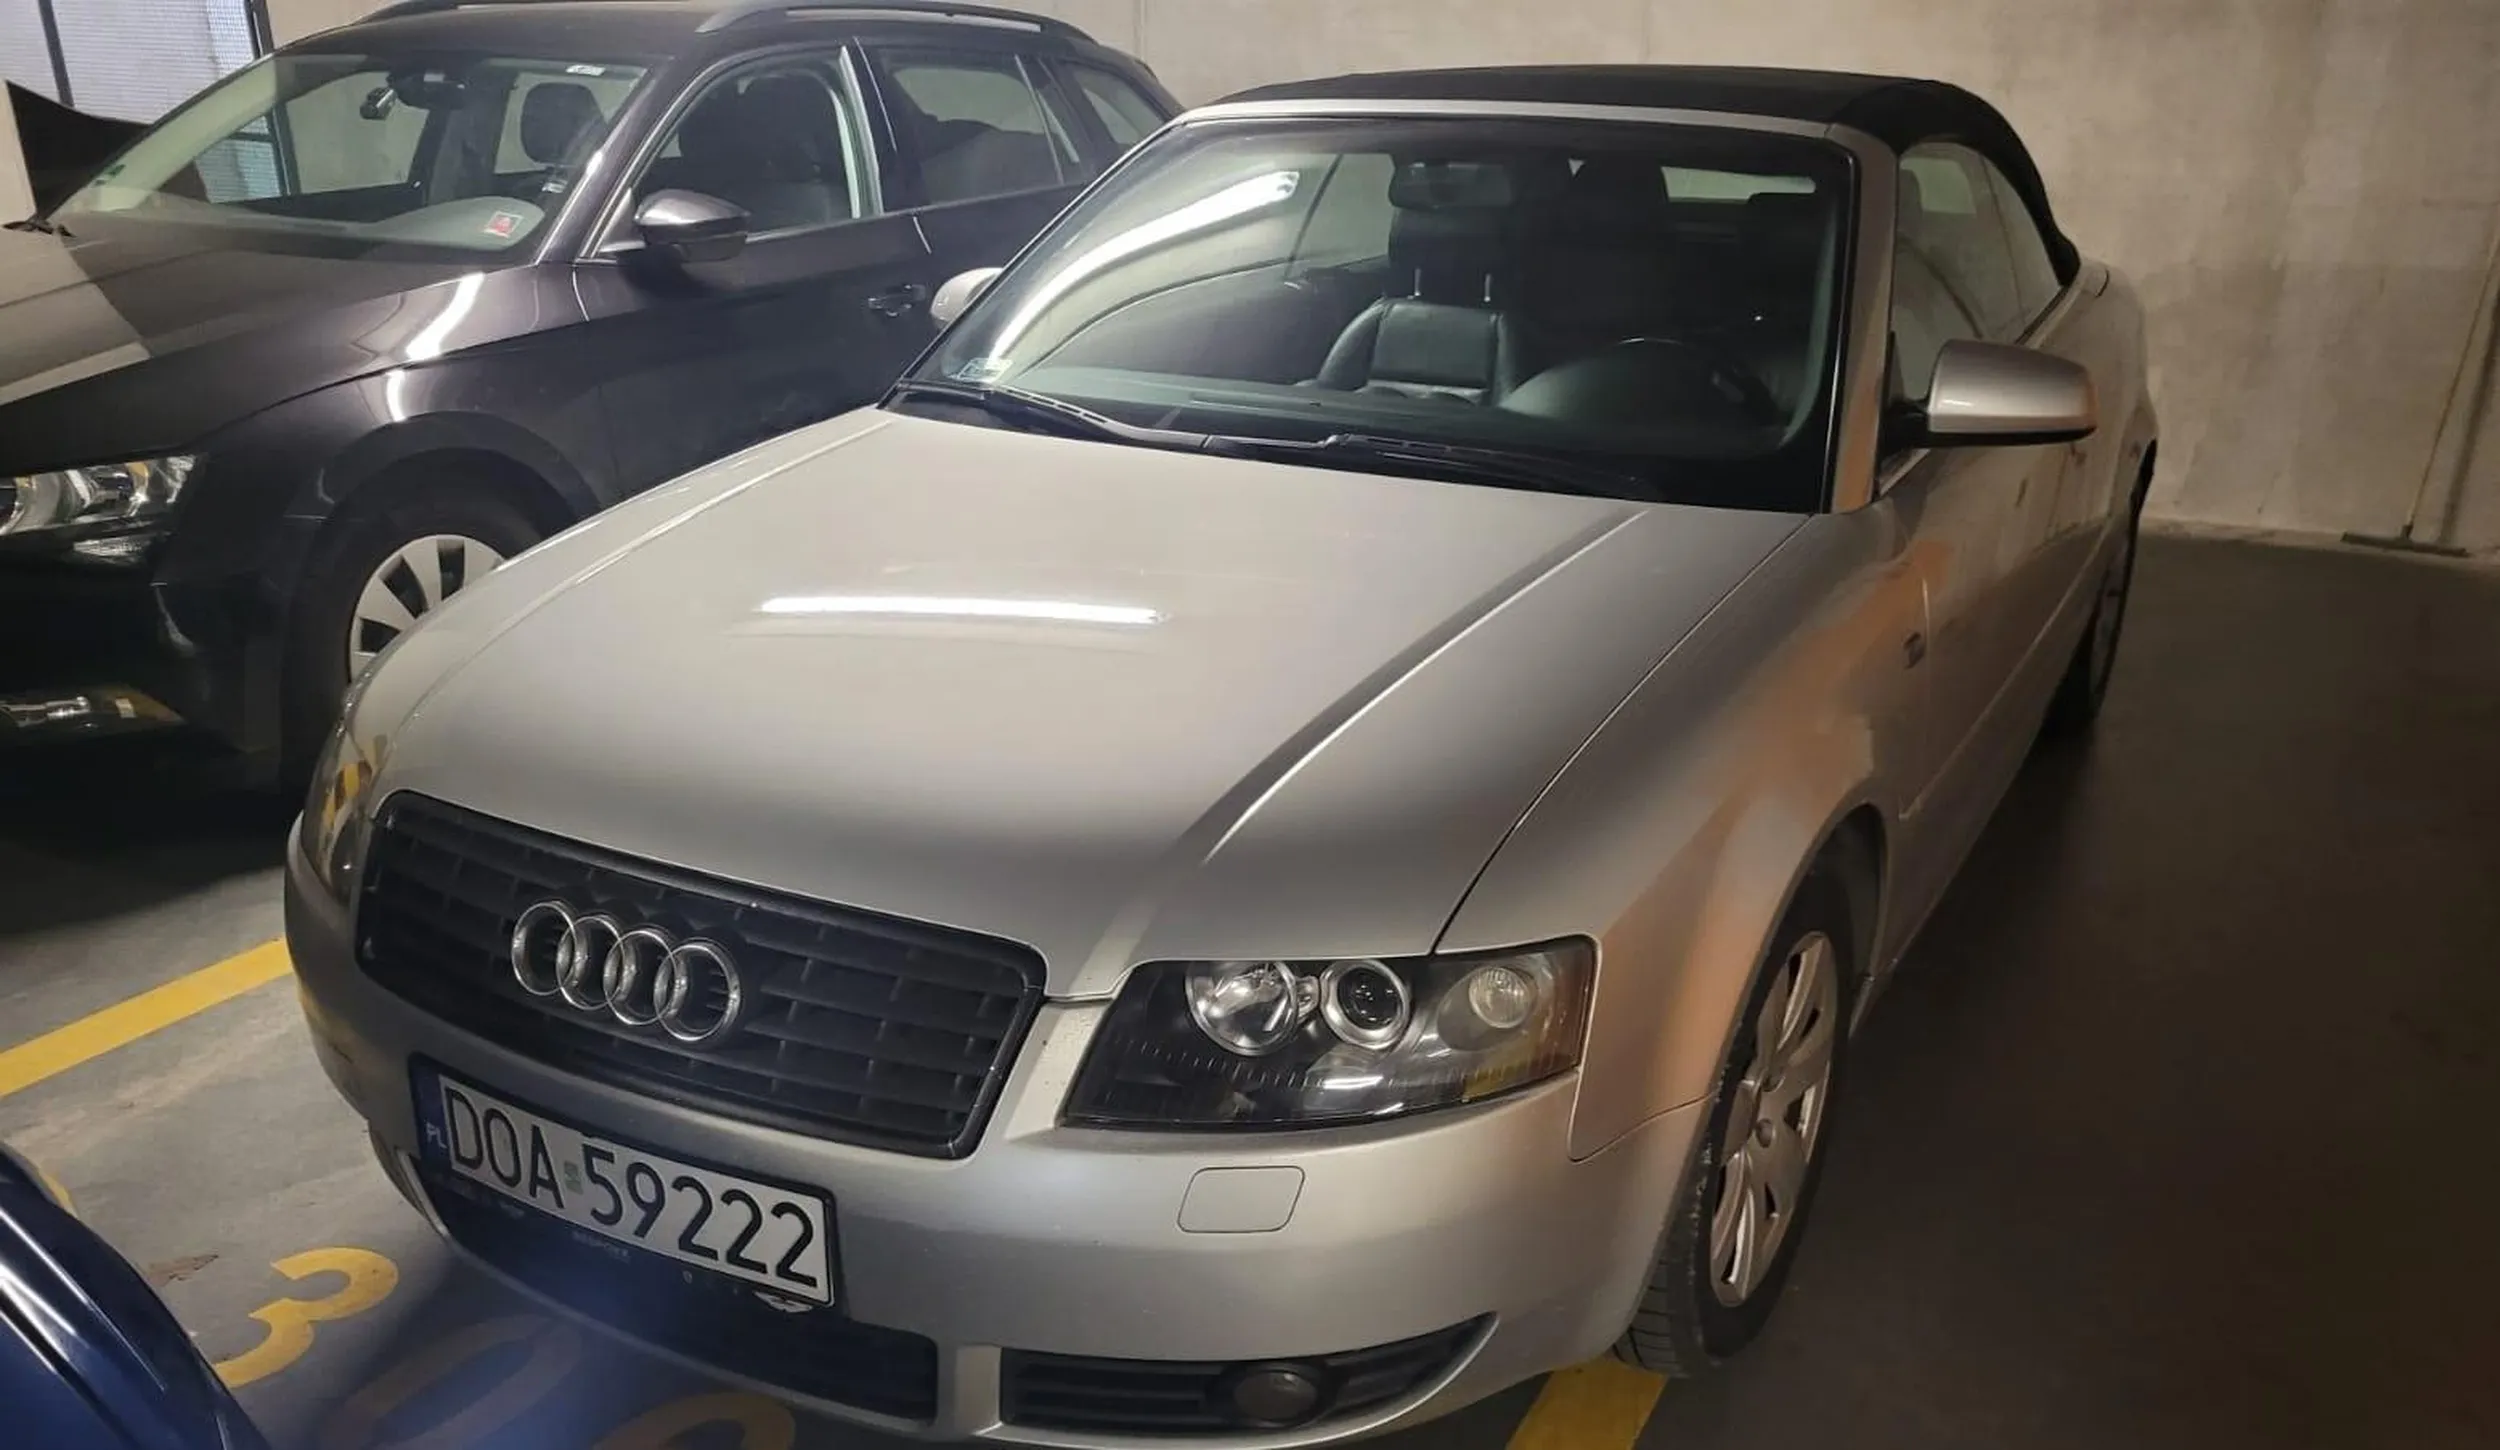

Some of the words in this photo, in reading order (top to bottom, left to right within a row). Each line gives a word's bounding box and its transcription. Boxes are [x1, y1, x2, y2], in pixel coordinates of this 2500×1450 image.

[425, 1121, 447, 1150] PL
[444, 1086, 564, 1210] DOA
[581, 1143, 818, 1289] 59222
